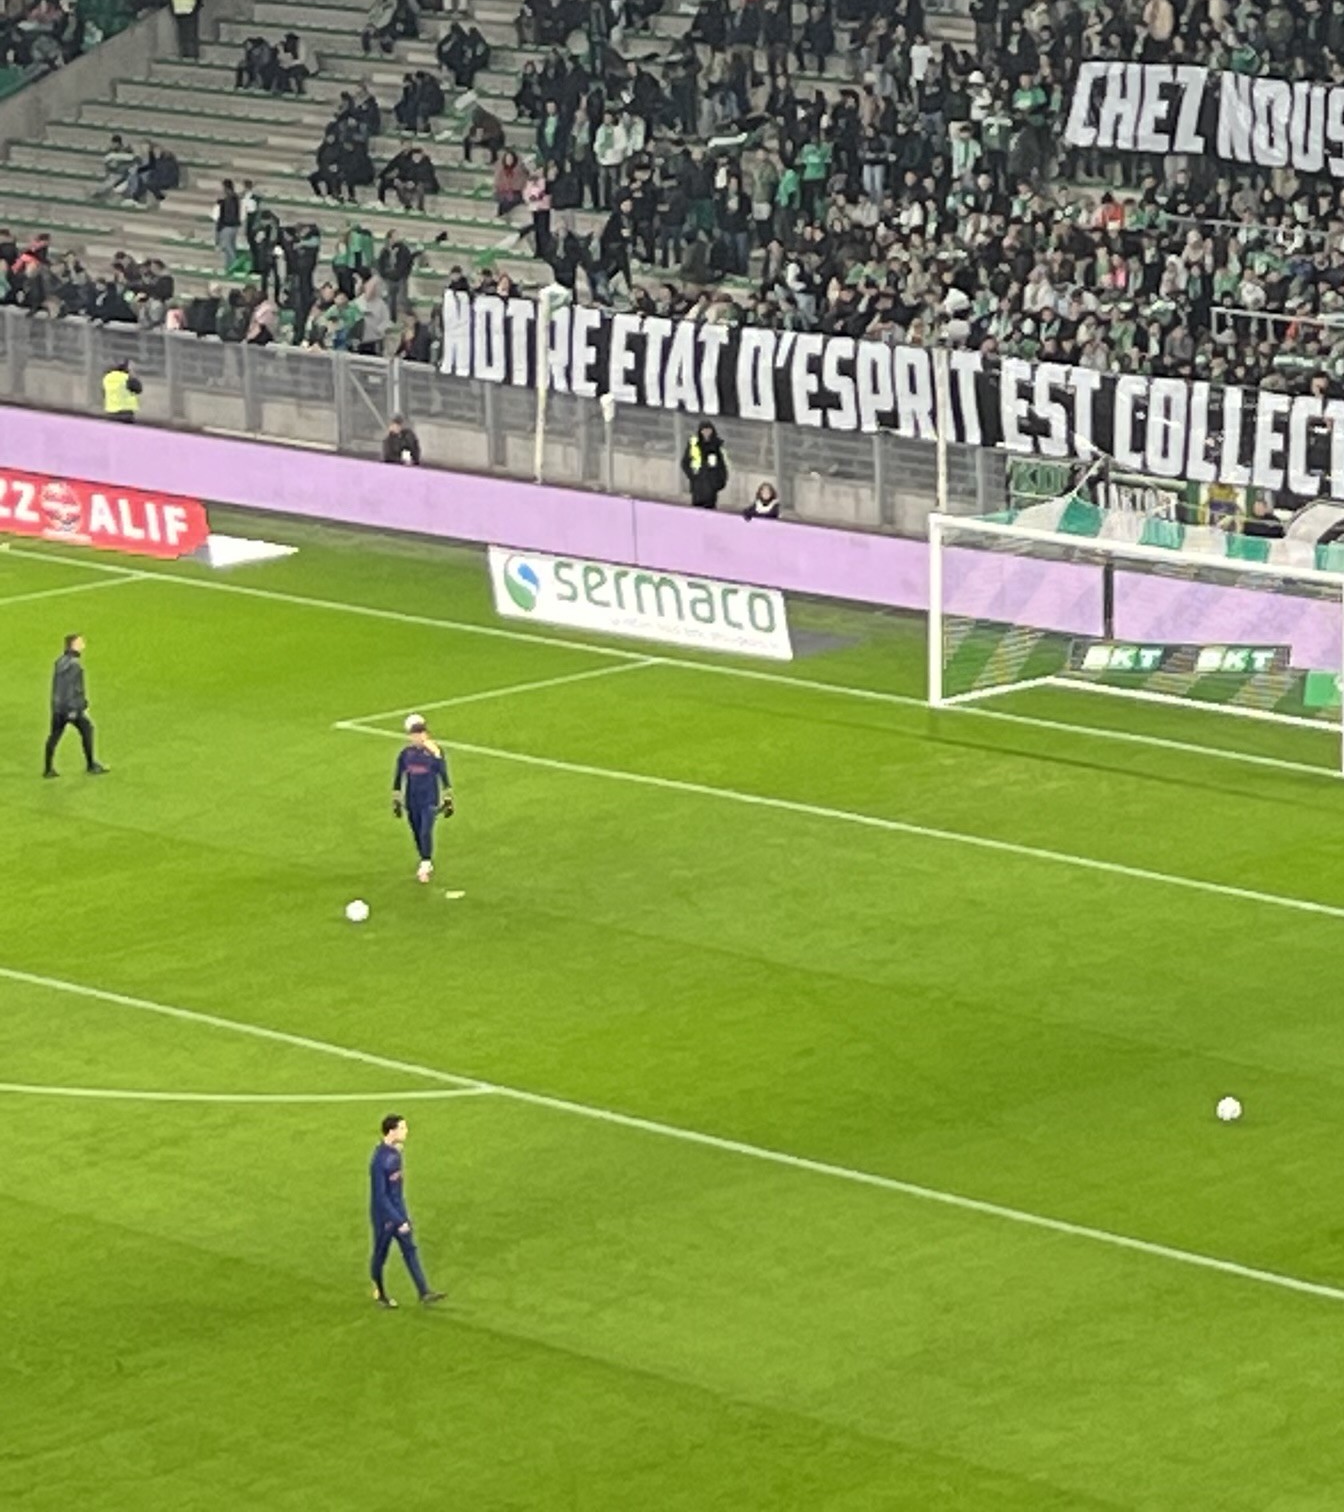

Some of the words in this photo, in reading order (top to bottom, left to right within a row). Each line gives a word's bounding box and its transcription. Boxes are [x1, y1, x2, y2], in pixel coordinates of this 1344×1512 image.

[1065, 61, 1207, 153] CHEZ
[440, 291, 601, 397] NOTRE
[609, 313, 731, 414] ETAT
[998, 356, 1102, 456] EST
[89, 493, 189, 546] ALIF
[553, 560, 776, 634] sermaco
[1080, 645, 1165, 671] BKT
[1196, 647, 1277, 673] BKT
